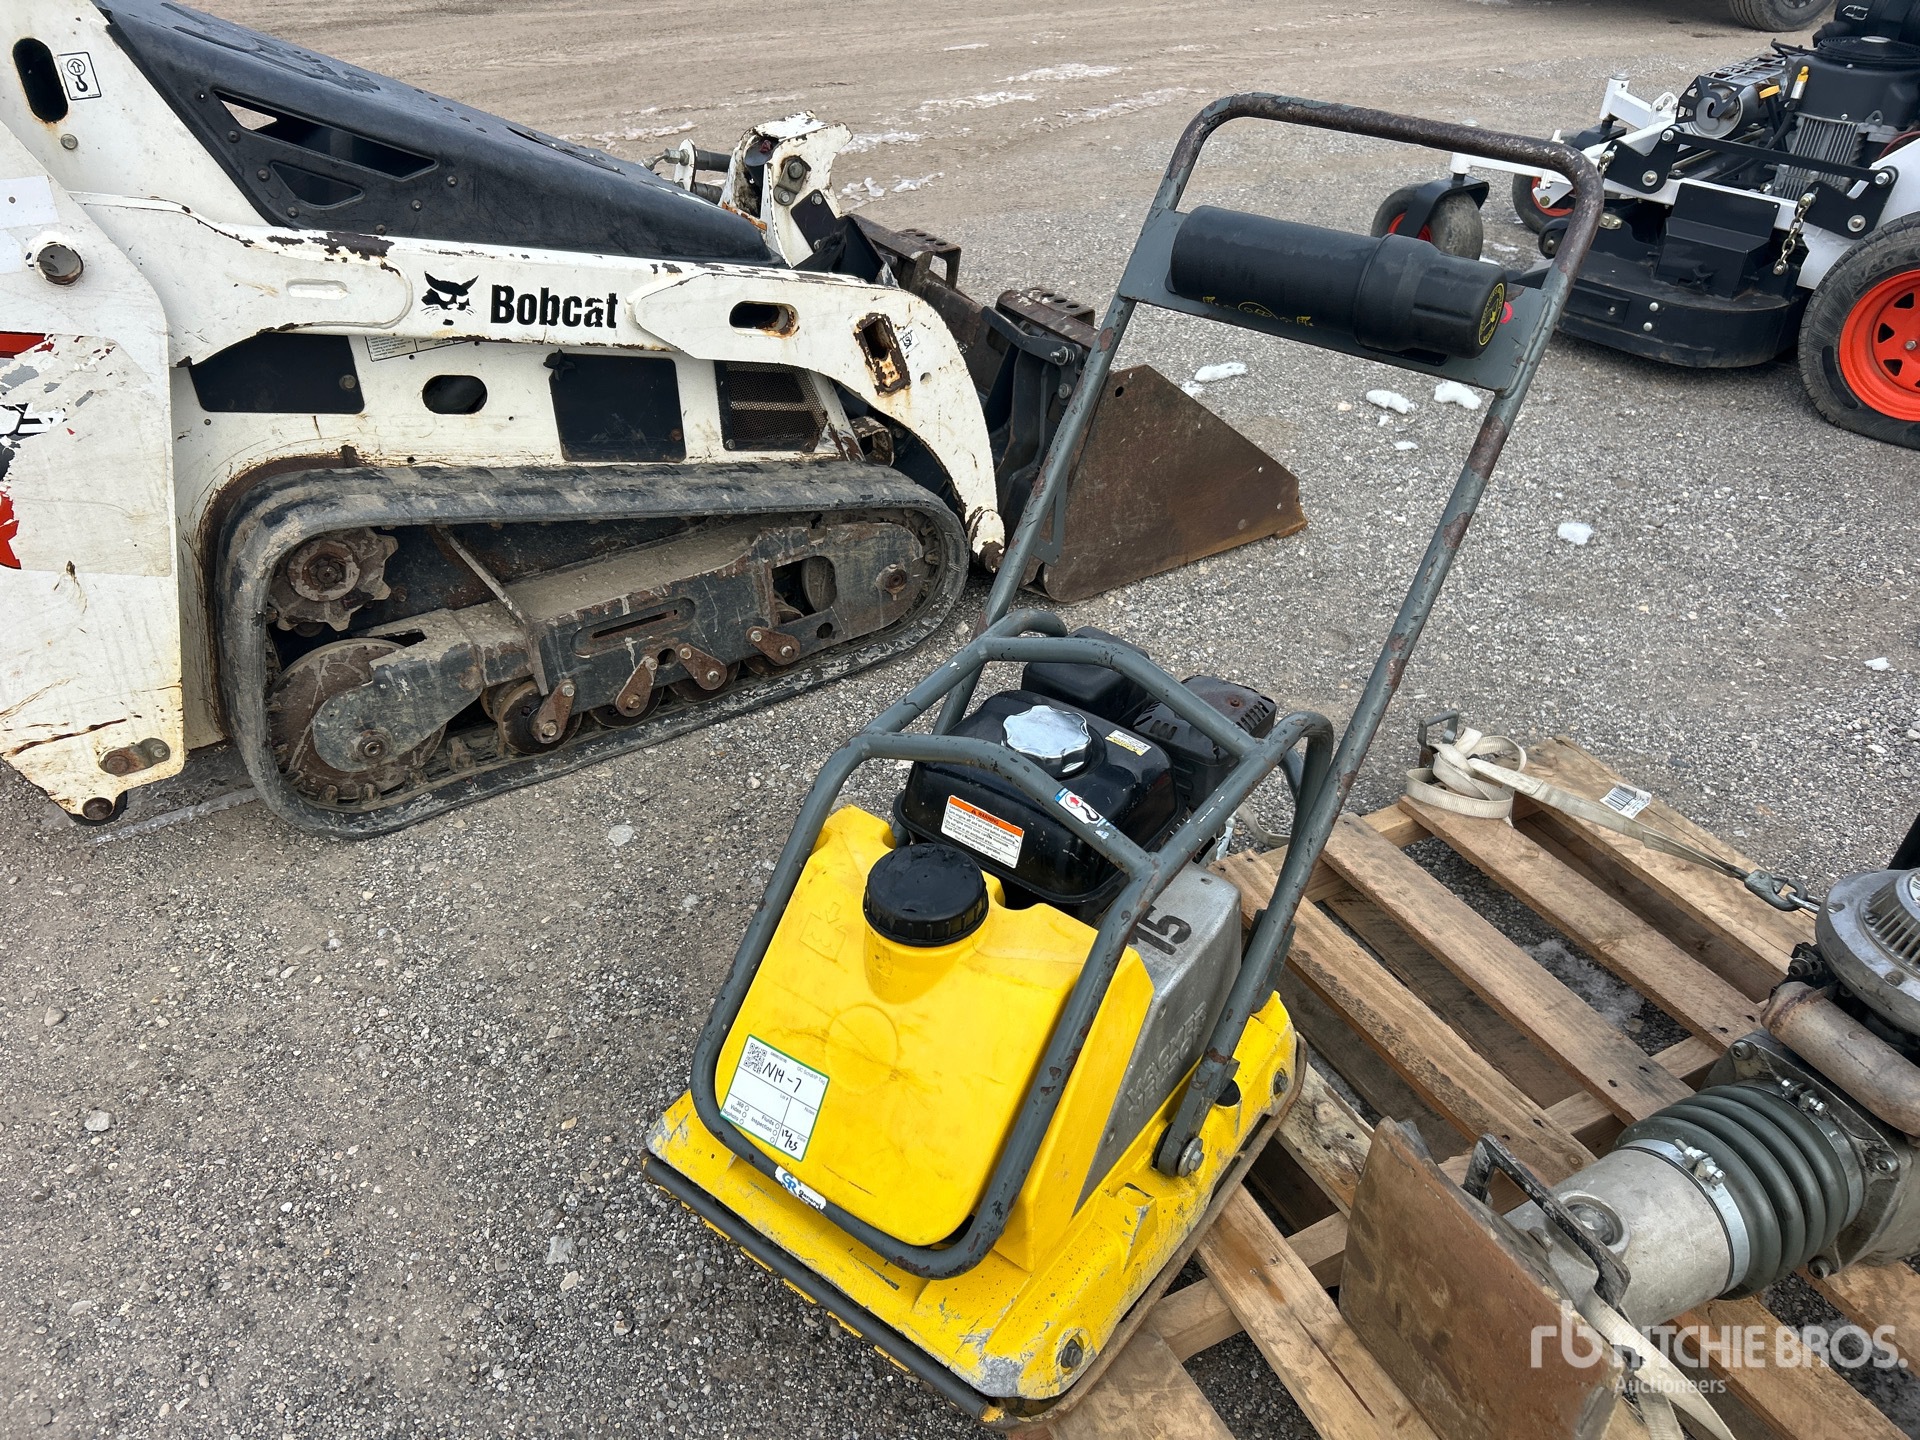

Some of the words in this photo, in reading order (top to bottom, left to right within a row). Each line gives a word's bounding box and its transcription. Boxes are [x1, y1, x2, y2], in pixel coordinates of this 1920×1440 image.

[490, 284, 618, 328] Bobcat
[978, 811, 998, 824] WARNING
[750, 1116, 772, 1133] Inspection
[761, 1114, 774, 1125] Fluids
